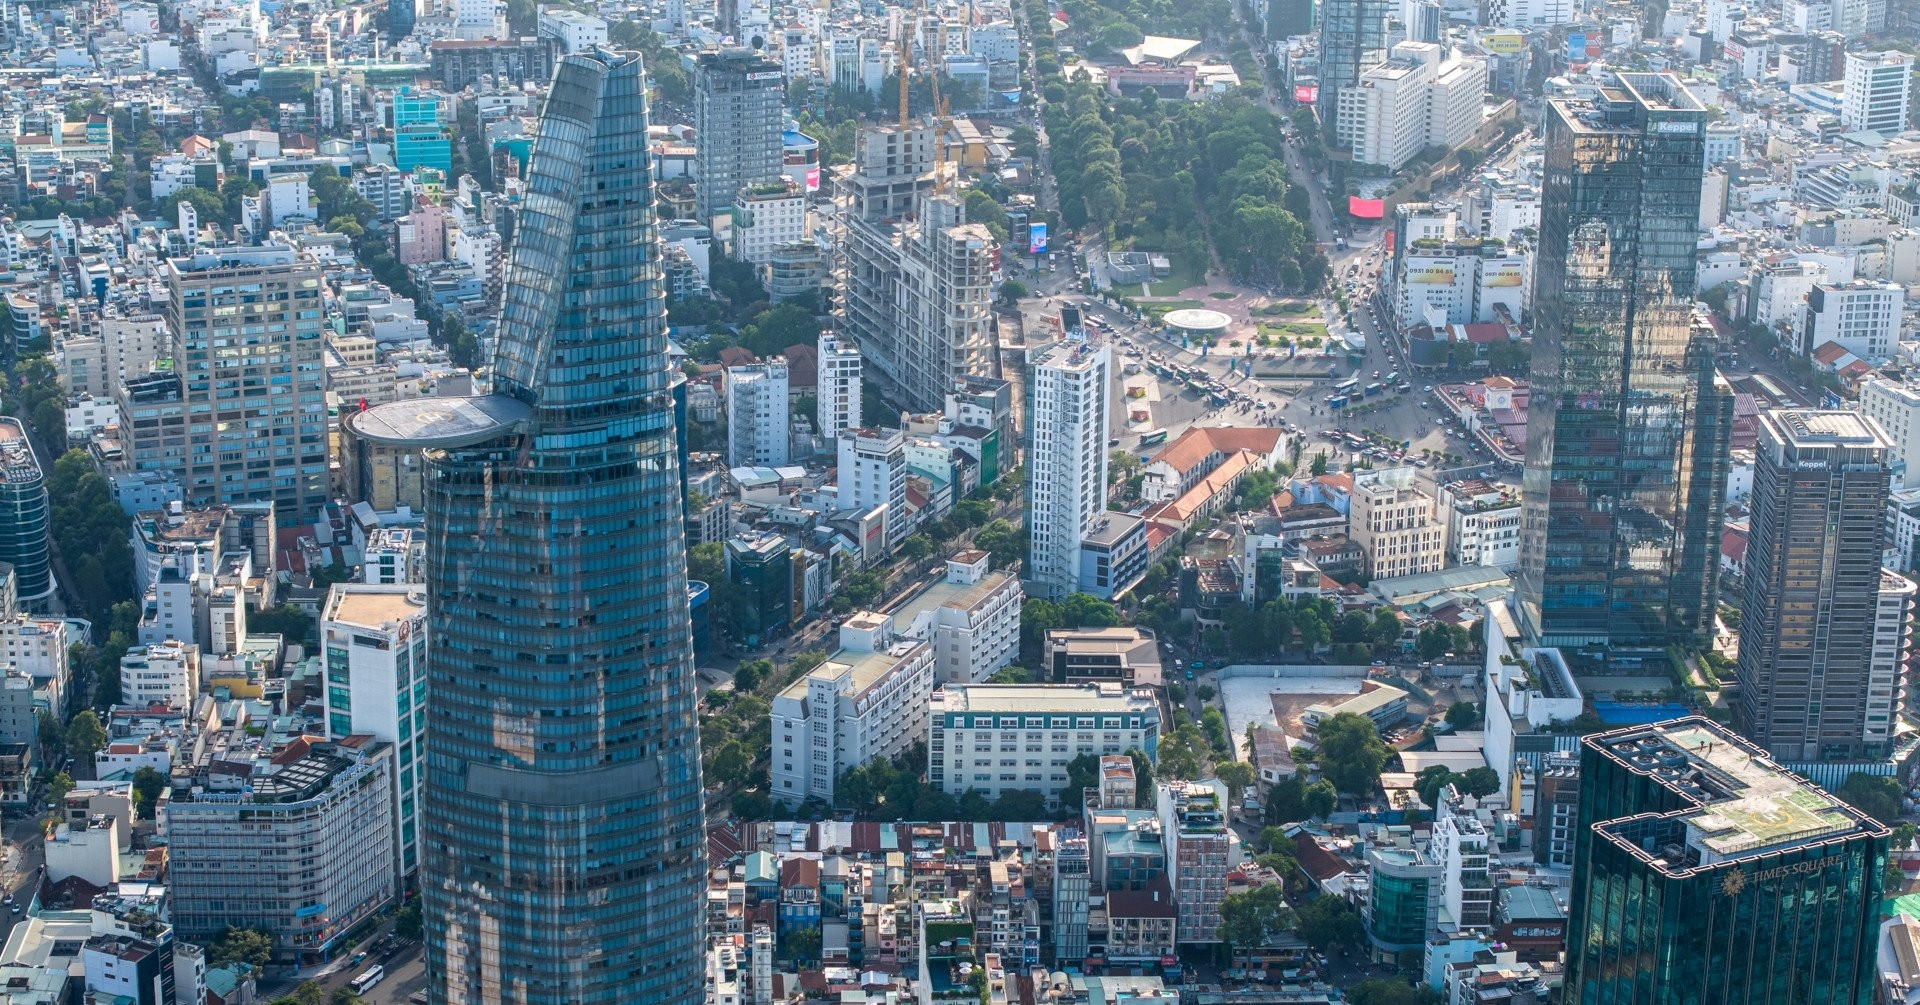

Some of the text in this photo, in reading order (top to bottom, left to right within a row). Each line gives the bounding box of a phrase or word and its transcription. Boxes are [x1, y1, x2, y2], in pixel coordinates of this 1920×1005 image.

[1660, 122, 1696, 132] Keppel
[1798, 460, 1826, 468] Keppel
[1763, 814, 1781, 823] H
[1752, 854, 1842, 882] TIMES SQUARE
